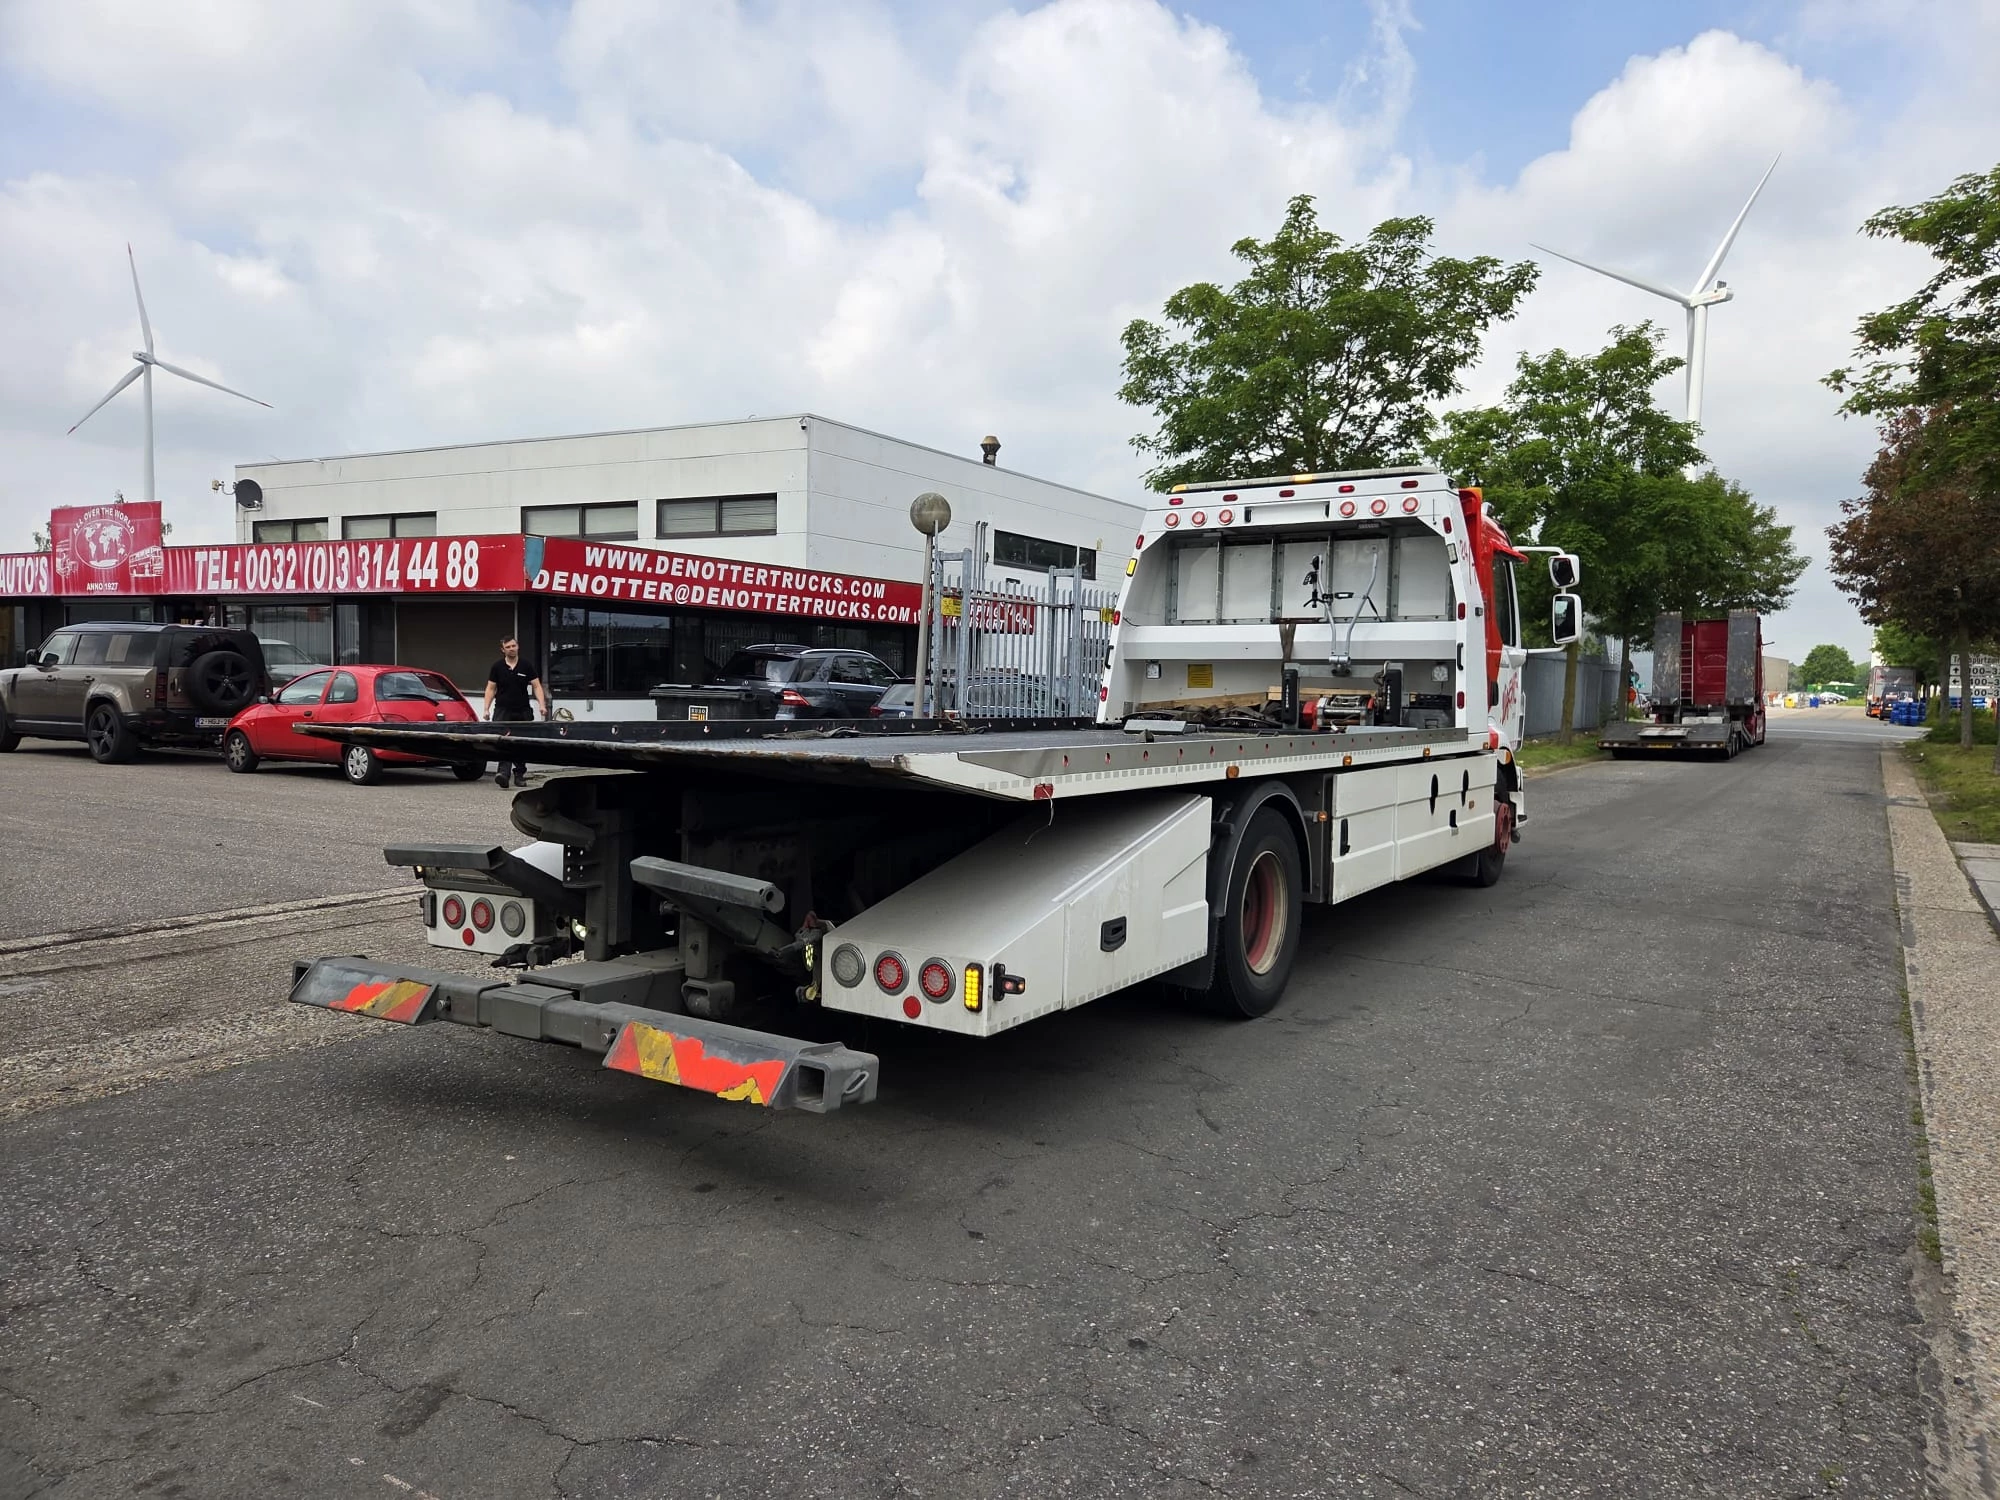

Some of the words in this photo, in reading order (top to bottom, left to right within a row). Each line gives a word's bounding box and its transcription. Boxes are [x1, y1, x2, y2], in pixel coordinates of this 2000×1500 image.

[73, 519, 83, 535] ALL
[83, 507, 101, 521] OVER
[101, 507, 114, 517] THE
[114, 509, 136, 535] WORLD
[86, 582, 104, 591] ANNO
[105, 582, 119, 591] 1927
[195, 550, 239, 590] TEL:
[245, 547, 297, 590] 0032
[356, 543, 400, 589] 314
[407, 541, 439, 588] 44
[445, 540, 479, 588] 88
[585, 546, 886, 599] WWW.DENOTTERTRUCKS.COM
[531, 569, 911, 622] DENOTTER@DENOTTERTRUCKS.COM
